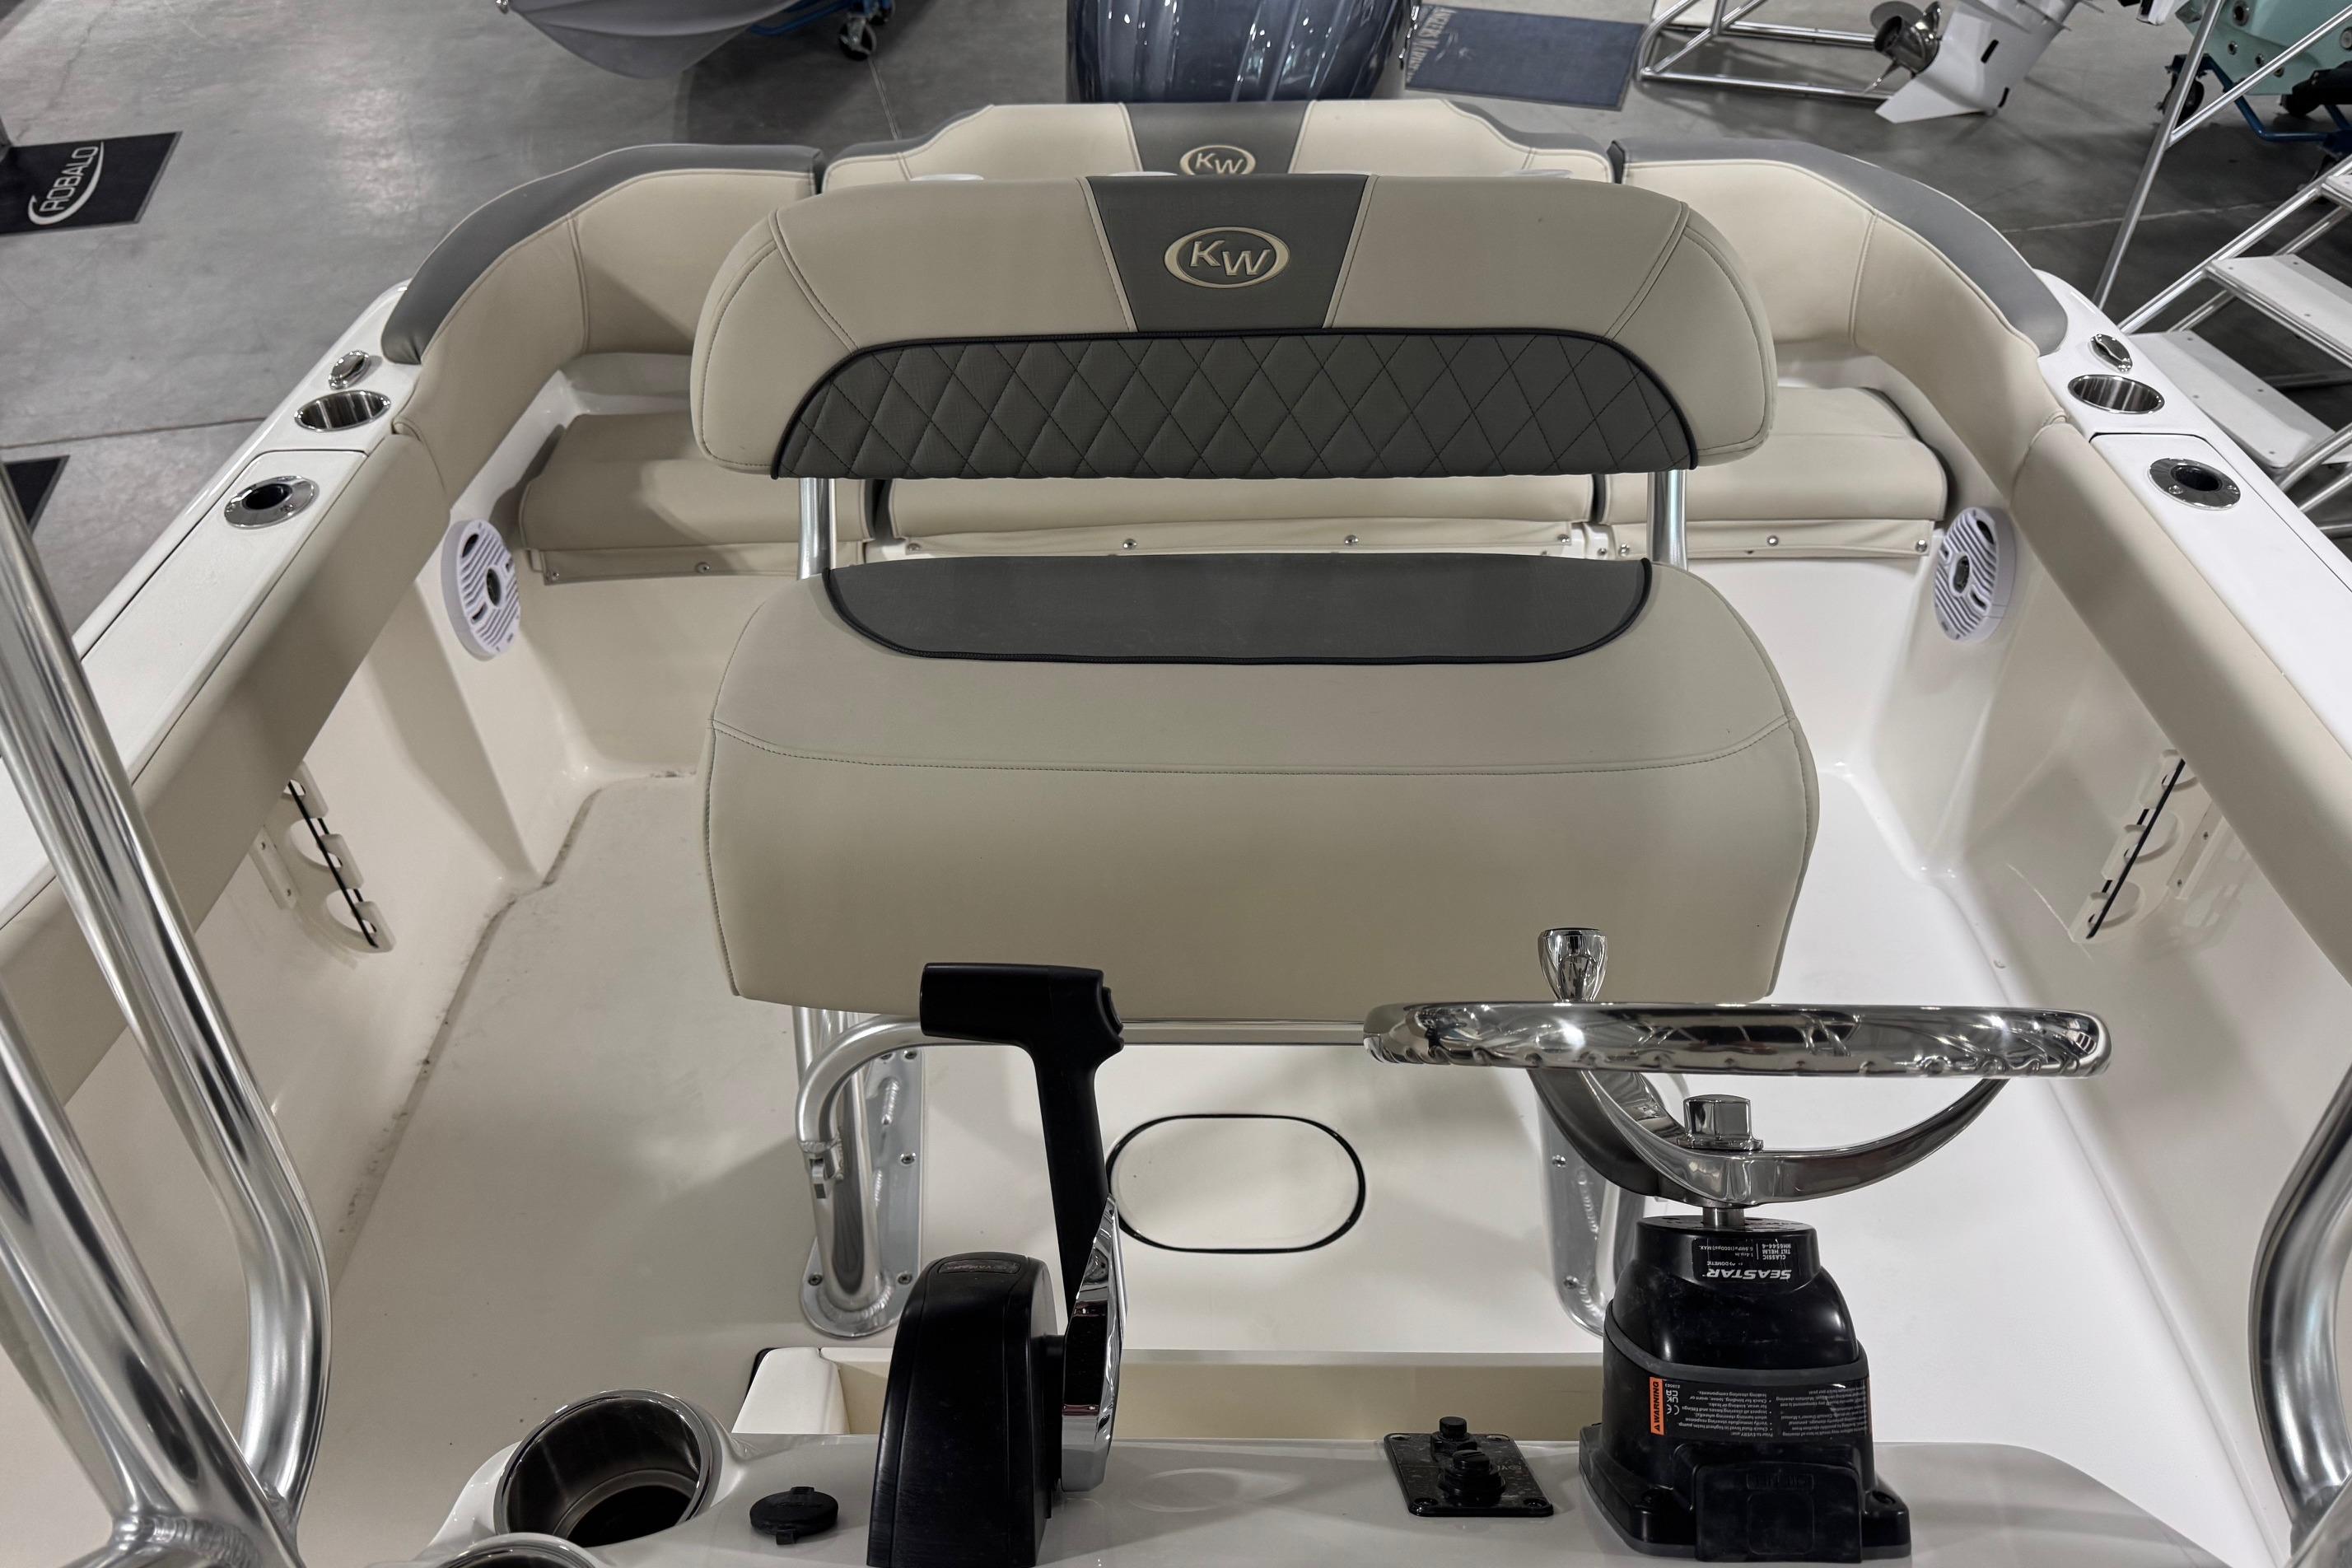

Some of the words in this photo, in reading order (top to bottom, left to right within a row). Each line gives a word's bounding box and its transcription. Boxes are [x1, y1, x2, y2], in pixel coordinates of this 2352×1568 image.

[39, 146, 99, 212] ROBALO
[1195, 152, 1244, 174] KW
[1189, 240, 1271, 276] KW
